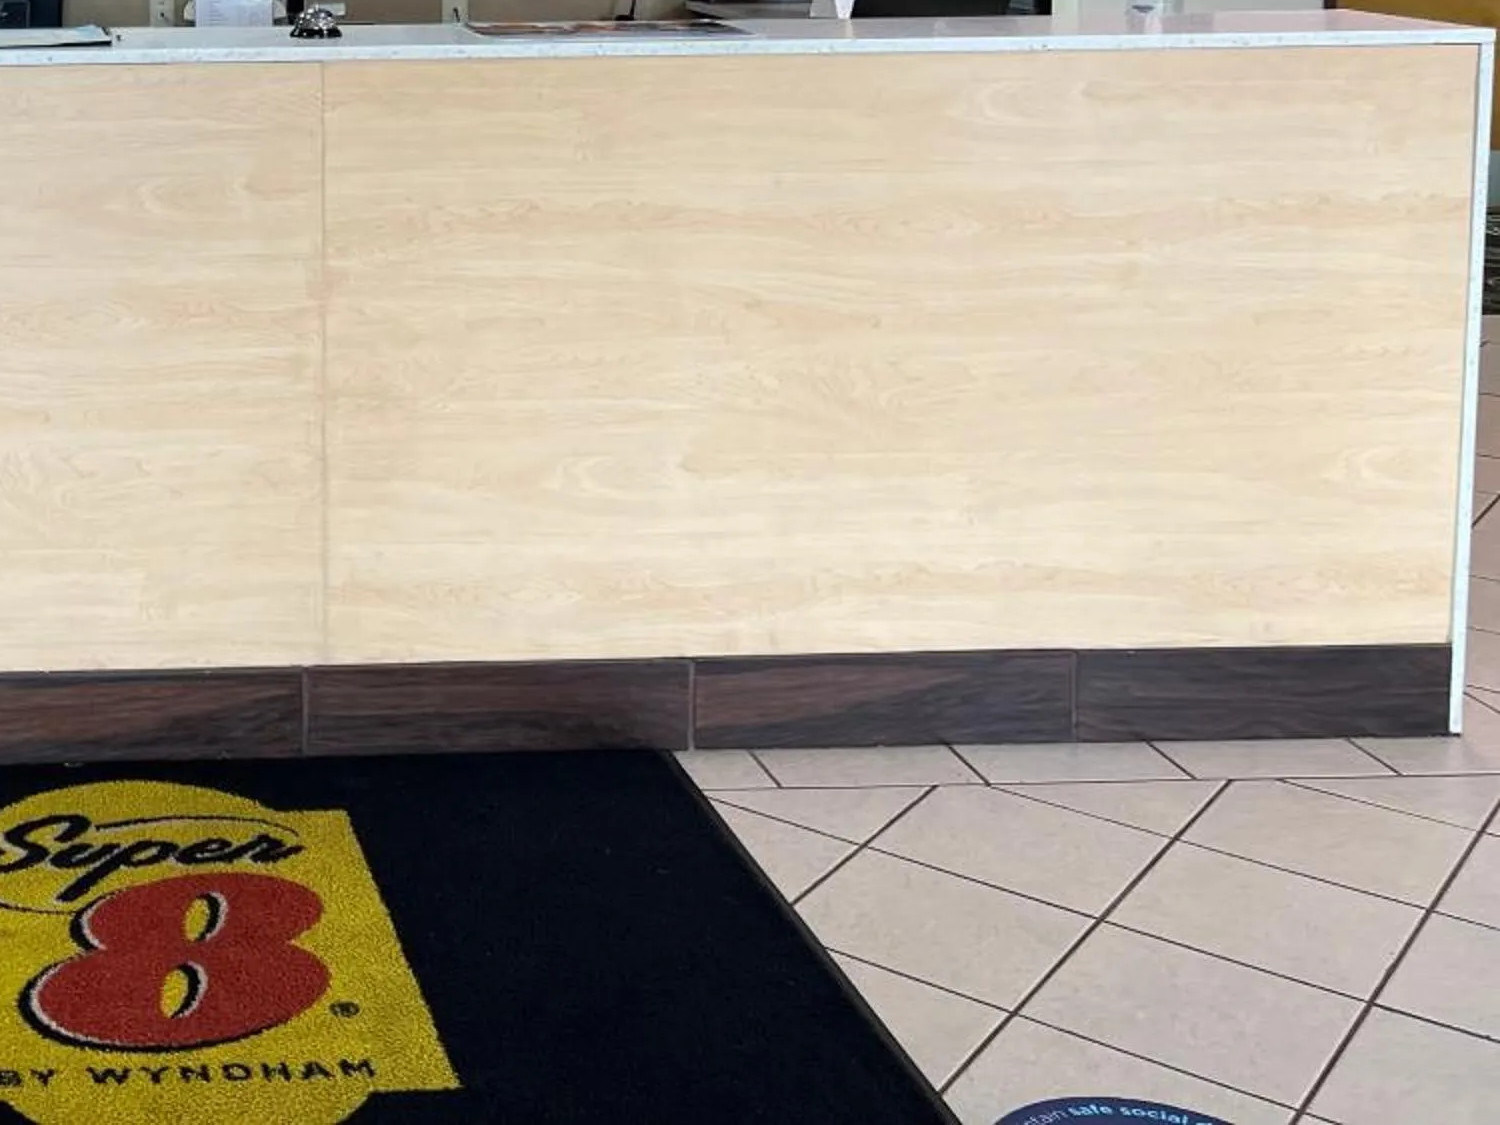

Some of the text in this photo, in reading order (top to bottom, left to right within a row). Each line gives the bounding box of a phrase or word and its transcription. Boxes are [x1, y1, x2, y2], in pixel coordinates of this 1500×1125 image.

[16, 871, 332, 1053] 8
[88, 1058, 378, 1087] WYNDHAM
[1067, 1104, 1113, 1117] safe
[1119, 1105, 1189, 1125] social
